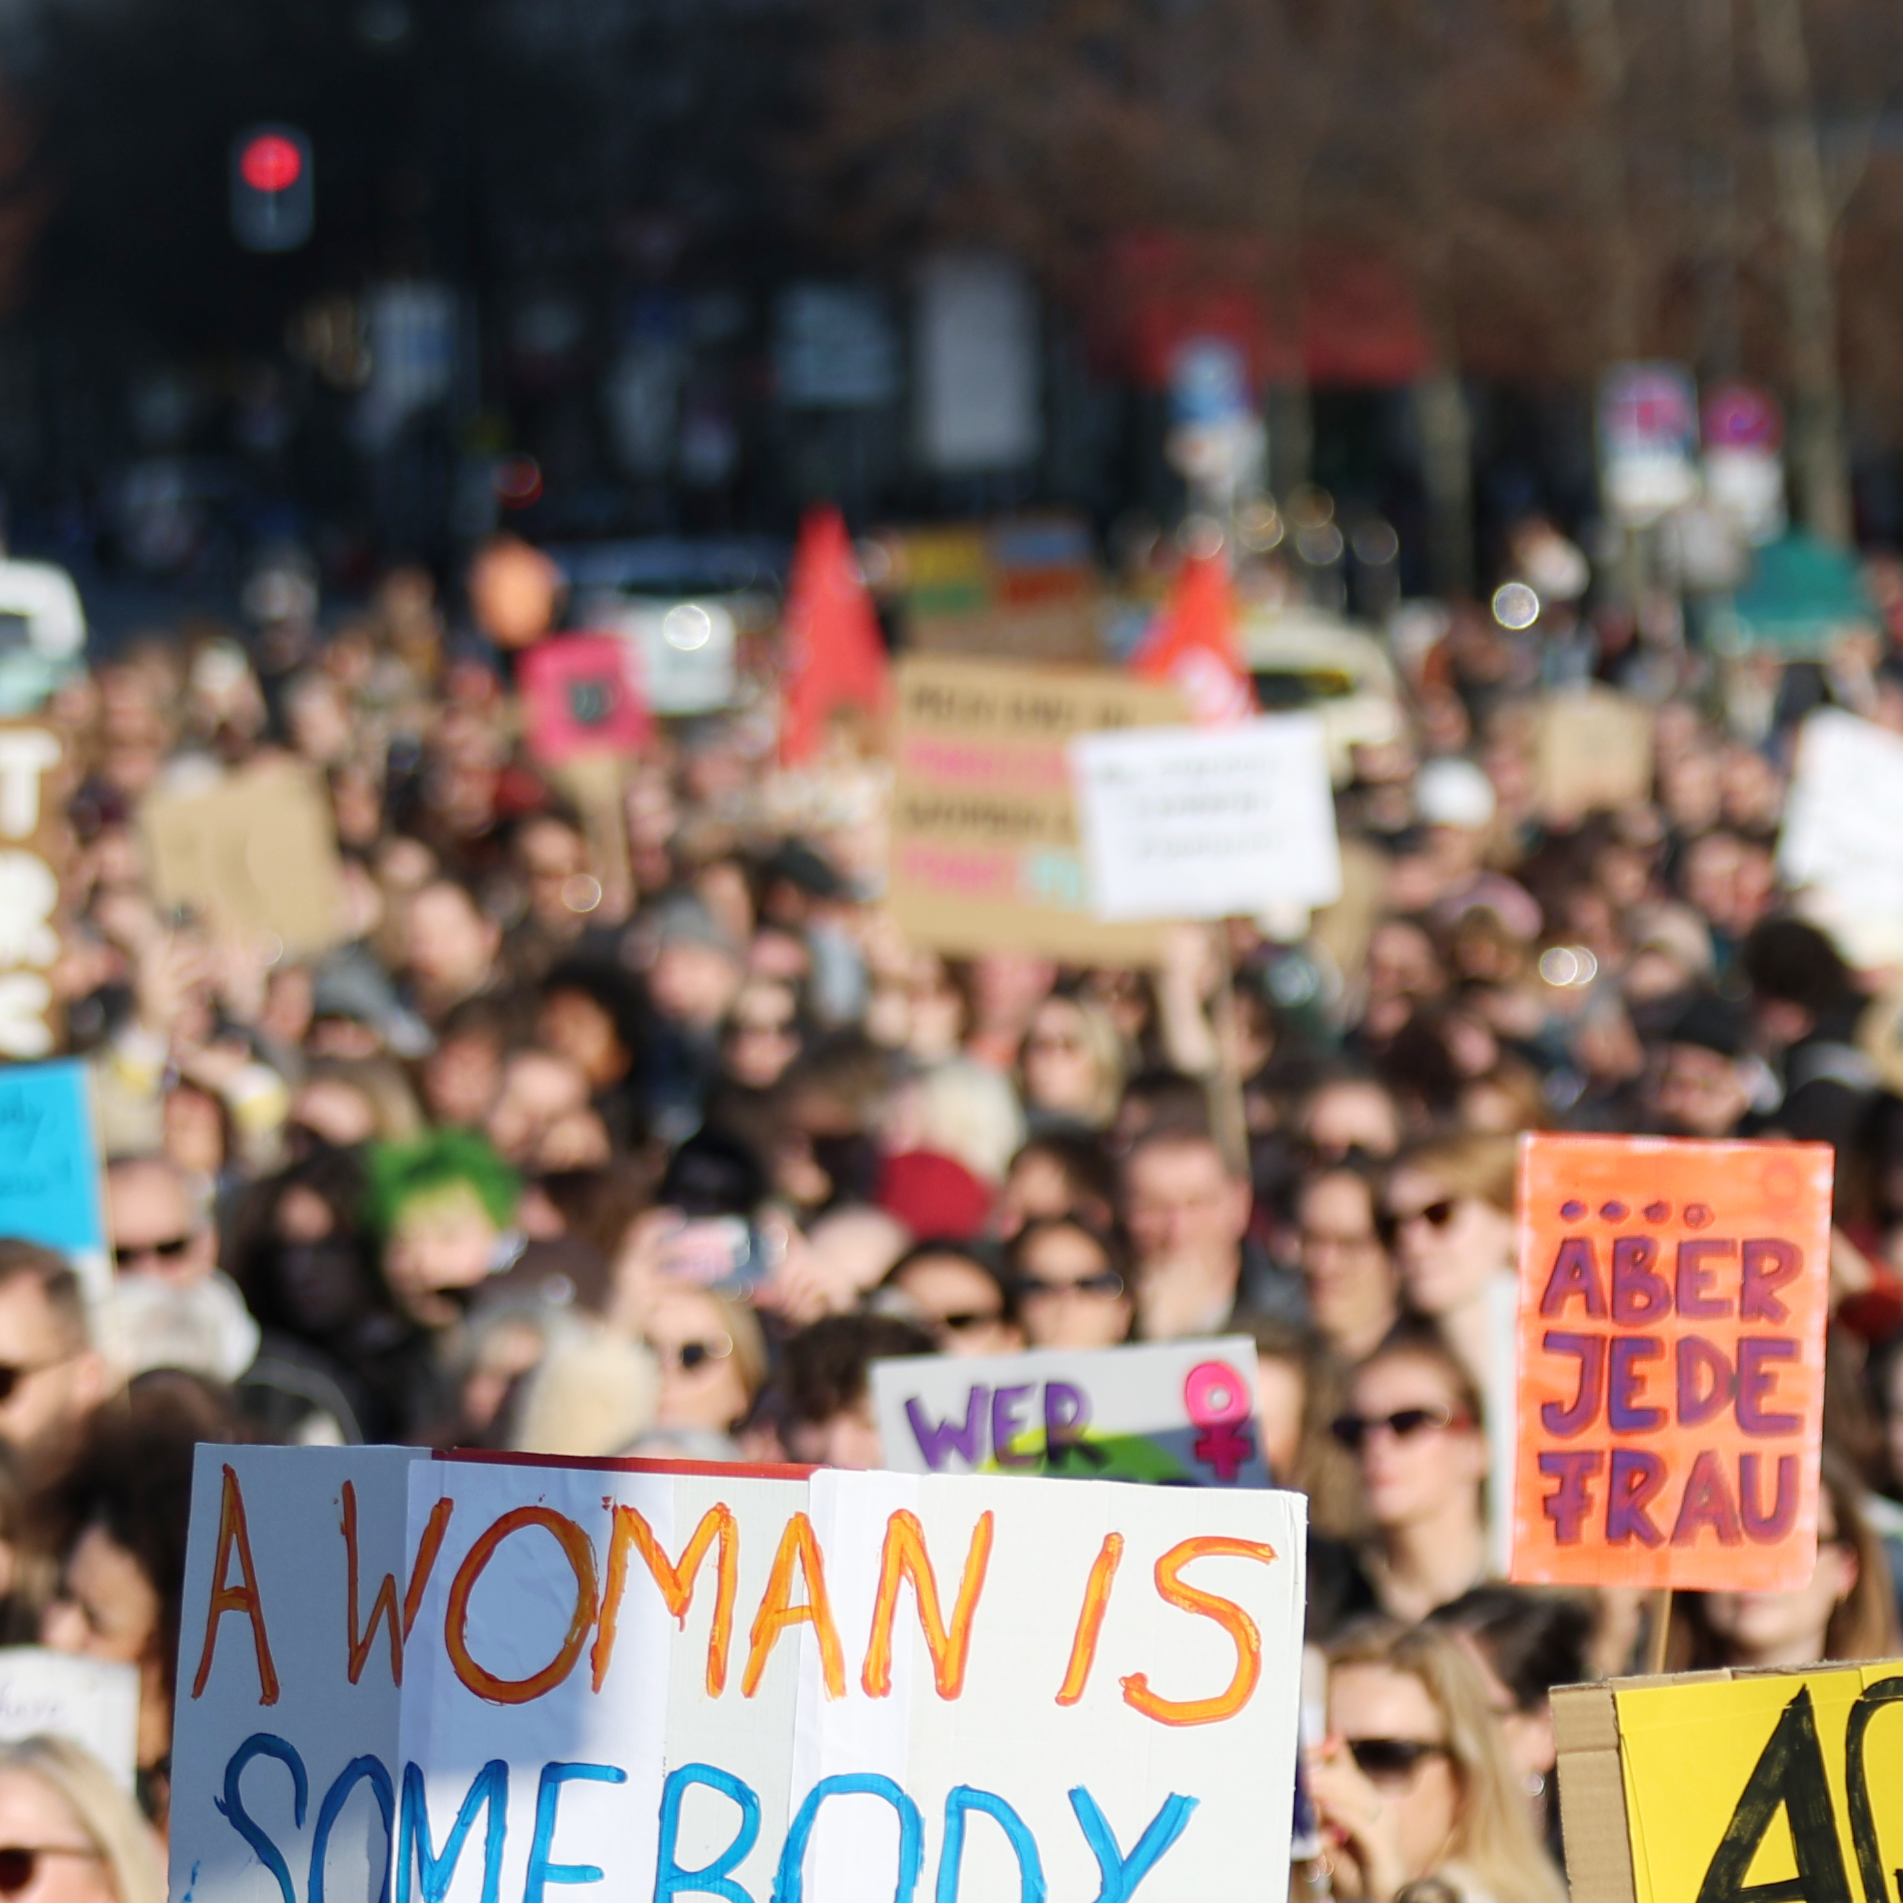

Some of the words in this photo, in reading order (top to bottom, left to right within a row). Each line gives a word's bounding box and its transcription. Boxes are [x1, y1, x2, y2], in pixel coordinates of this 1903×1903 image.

[1539, 1235, 1804, 1327] ABER
[904, 1380, 1112, 1471] WER
[1541, 1331, 1805, 1439] JEDE
[1538, 1448, 1801, 1549] FRAU
[191, 1463, 280, 1707] A
[341, 1479, 994, 1707] WOMAN
[1055, 1532, 1278, 1727] IS
